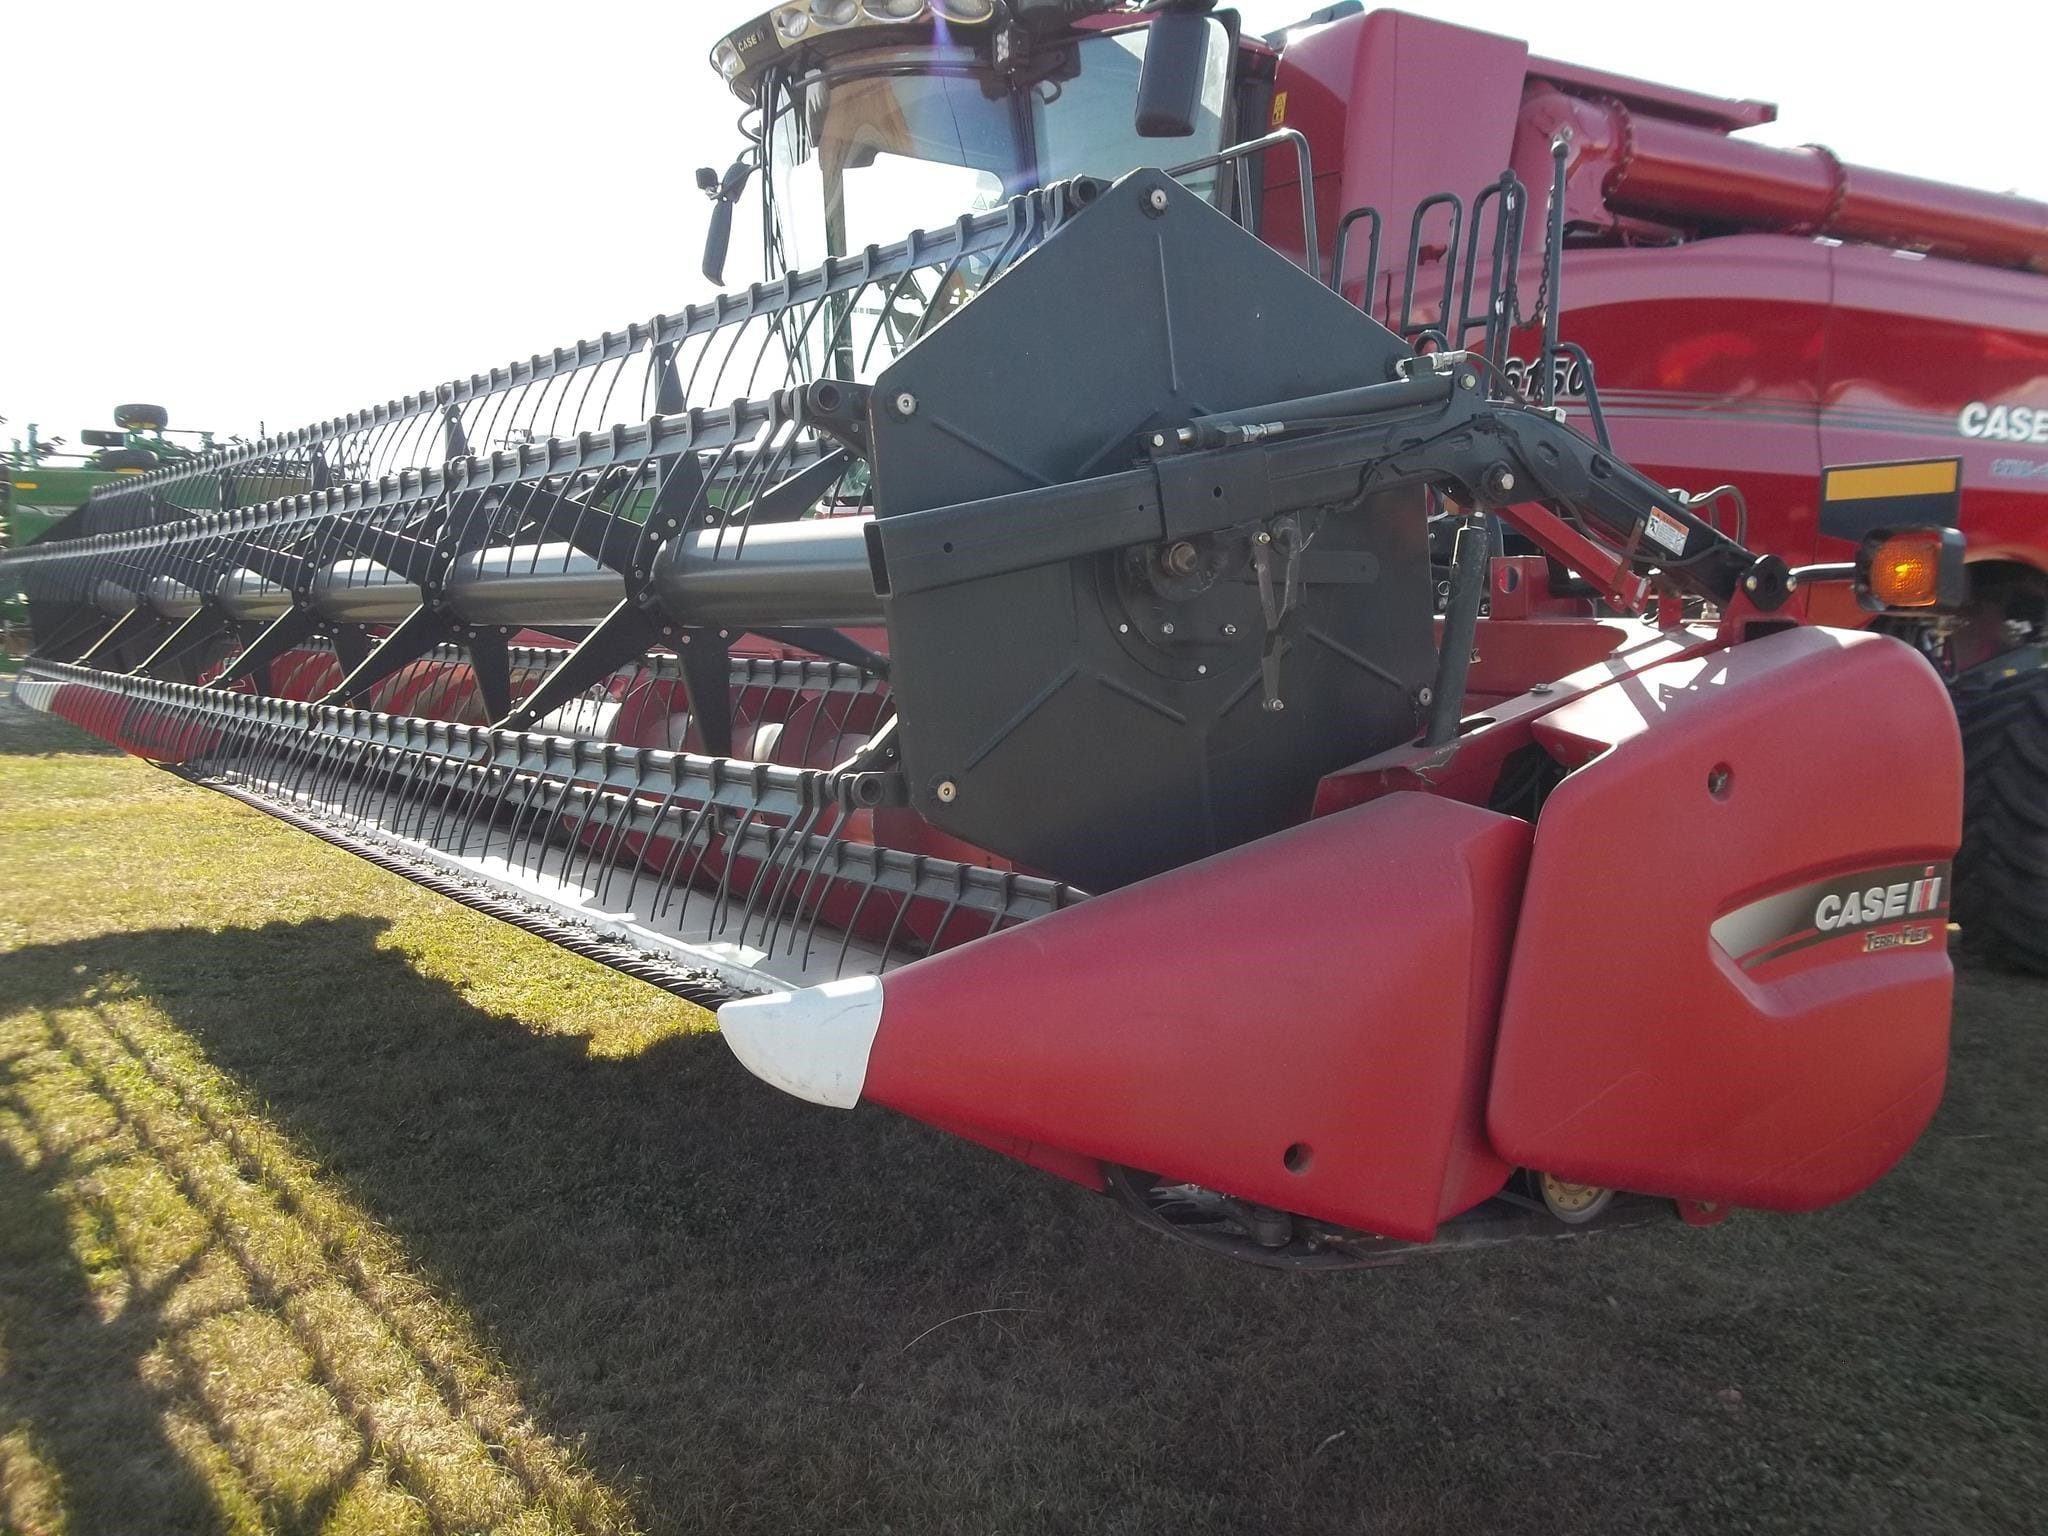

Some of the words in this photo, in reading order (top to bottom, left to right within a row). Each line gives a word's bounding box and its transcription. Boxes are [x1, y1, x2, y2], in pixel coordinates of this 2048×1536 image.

[738, 34, 757, 51] CASE
[1504, 357, 1594, 397] 6150
[1958, 401, 2048, 442] CASE
